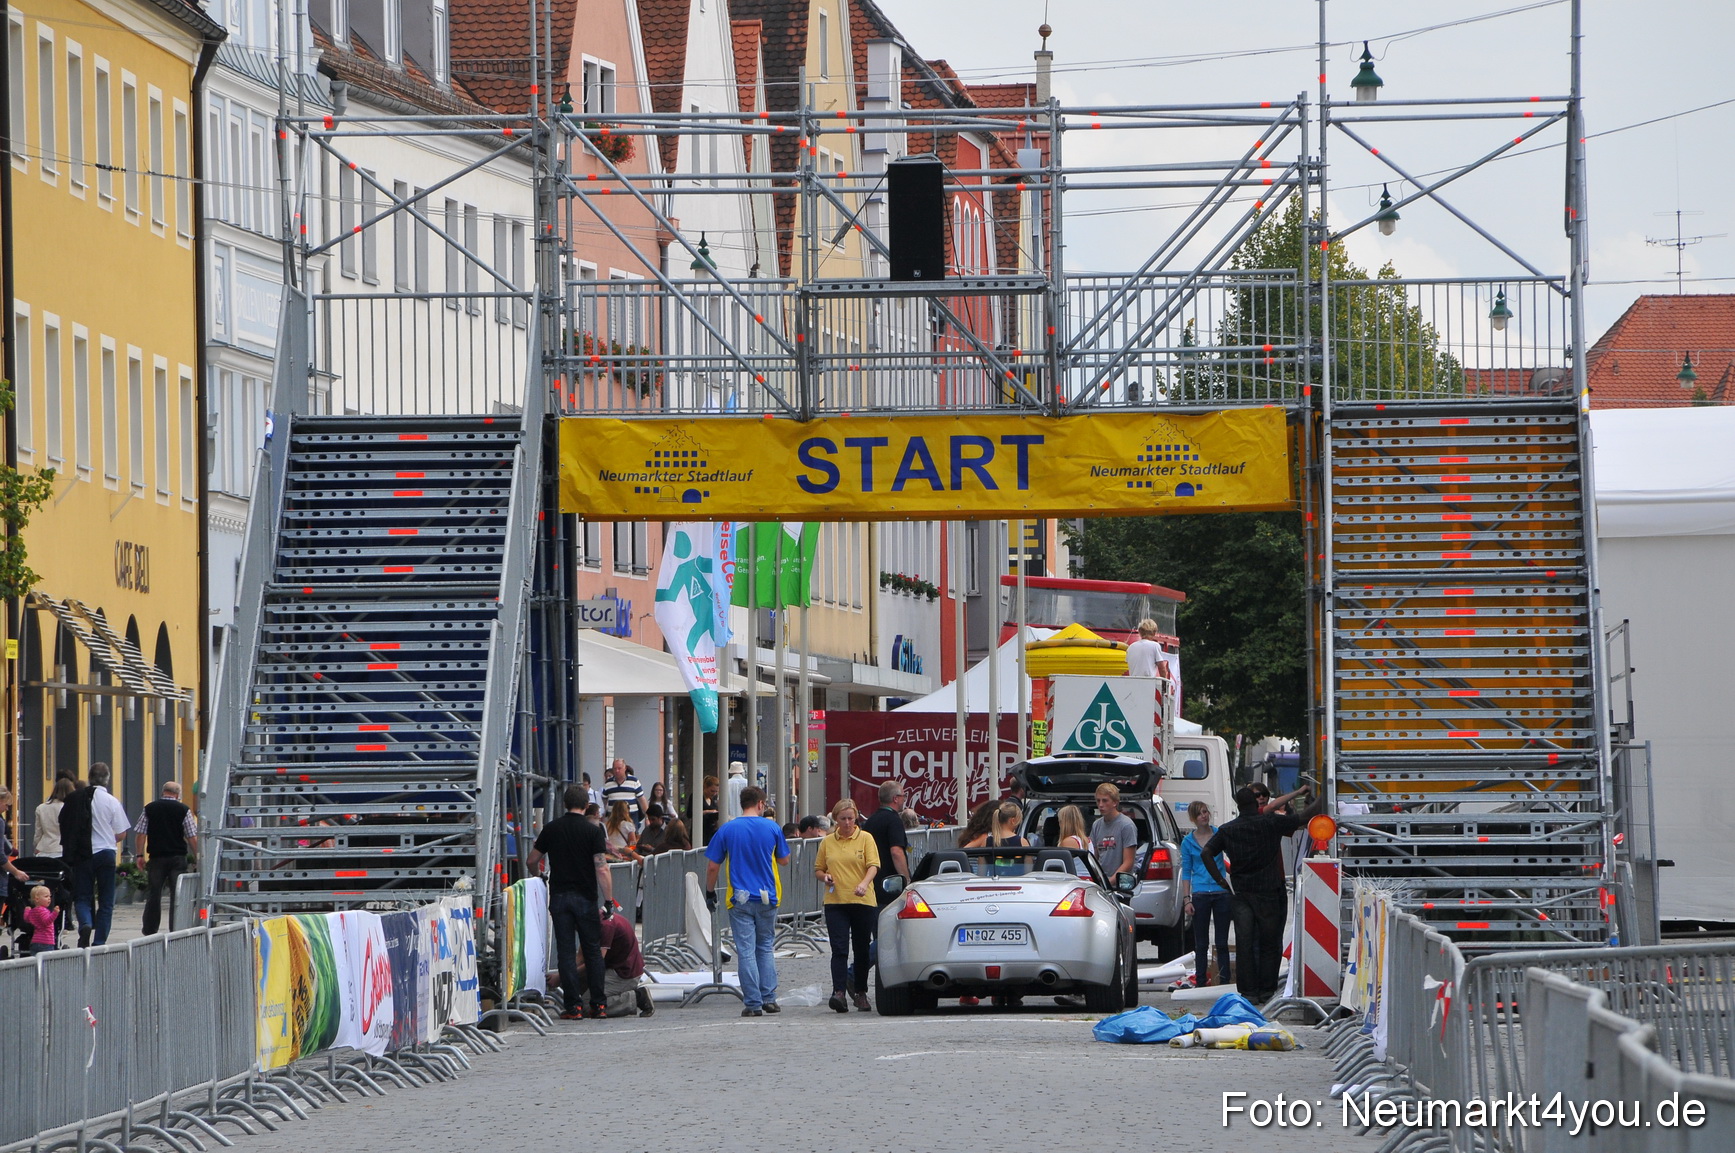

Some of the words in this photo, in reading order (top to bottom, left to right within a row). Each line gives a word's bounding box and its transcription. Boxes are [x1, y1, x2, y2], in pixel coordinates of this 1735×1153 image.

[796, 434, 1045, 494] START
[1090, 463, 1176, 478] Neumarkter
[1179, 461, 1247, 476] Stadtlauf
[598, 469, 684, 483] Neumarkter
[687, 467, 754, 483] Stadtlauf
[114, 539, 133, 590] CAFE
[578, 604, 613, 622] tor.
[896, 728, 991, 743] ZELTVEEI
[966, 930, 974, 941] N
[980, 930, 996, 941] QZ
[1001, 929, 1022, 941] 455
